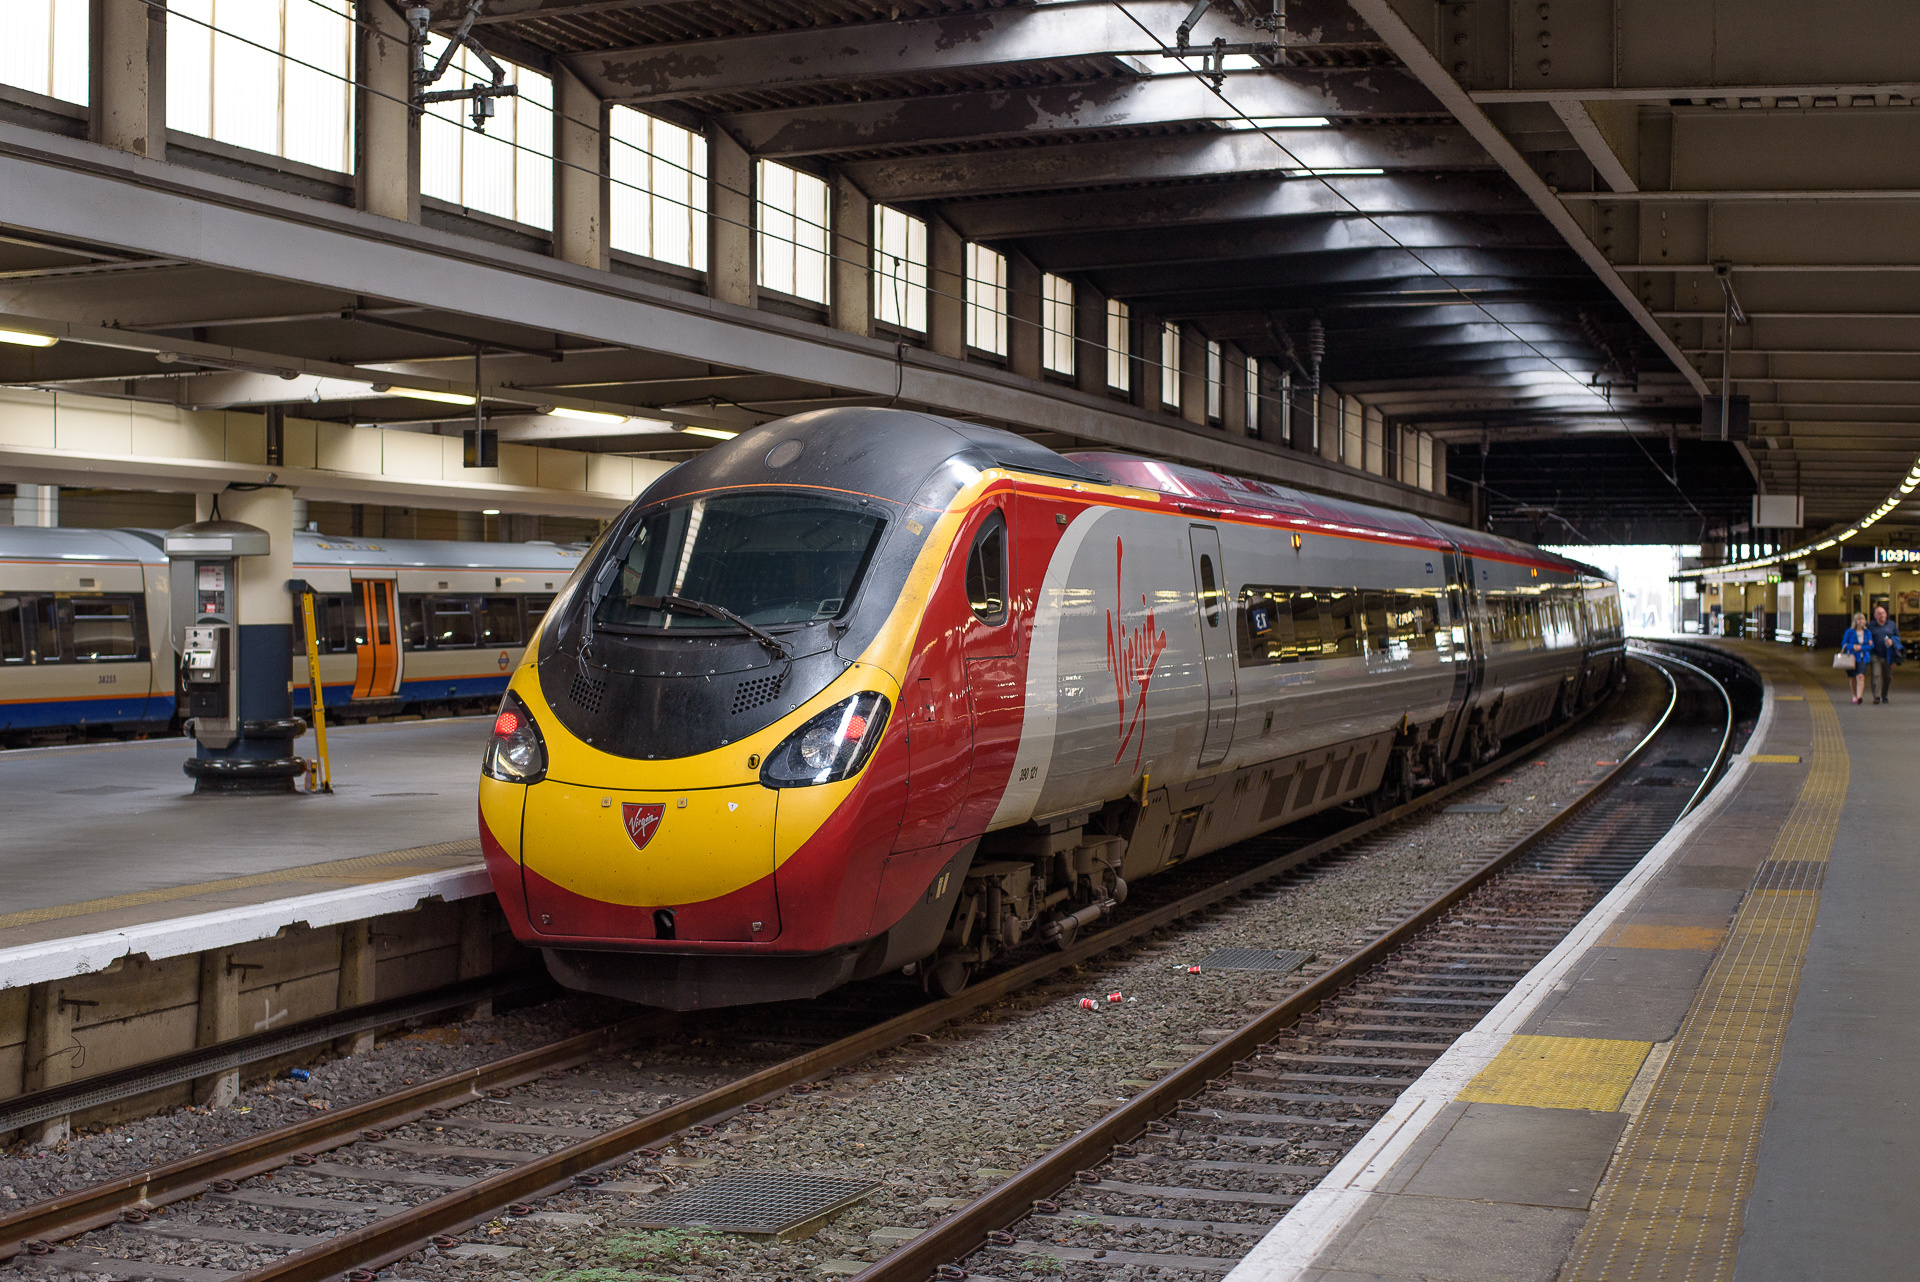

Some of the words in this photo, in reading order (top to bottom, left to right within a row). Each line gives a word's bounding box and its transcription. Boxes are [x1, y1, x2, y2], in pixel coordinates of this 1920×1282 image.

[1880, 549, 1909, 562] 10:31
[1106, 535, 1167, 777] Virgin
[629, 807, 659, 837] Virgin
